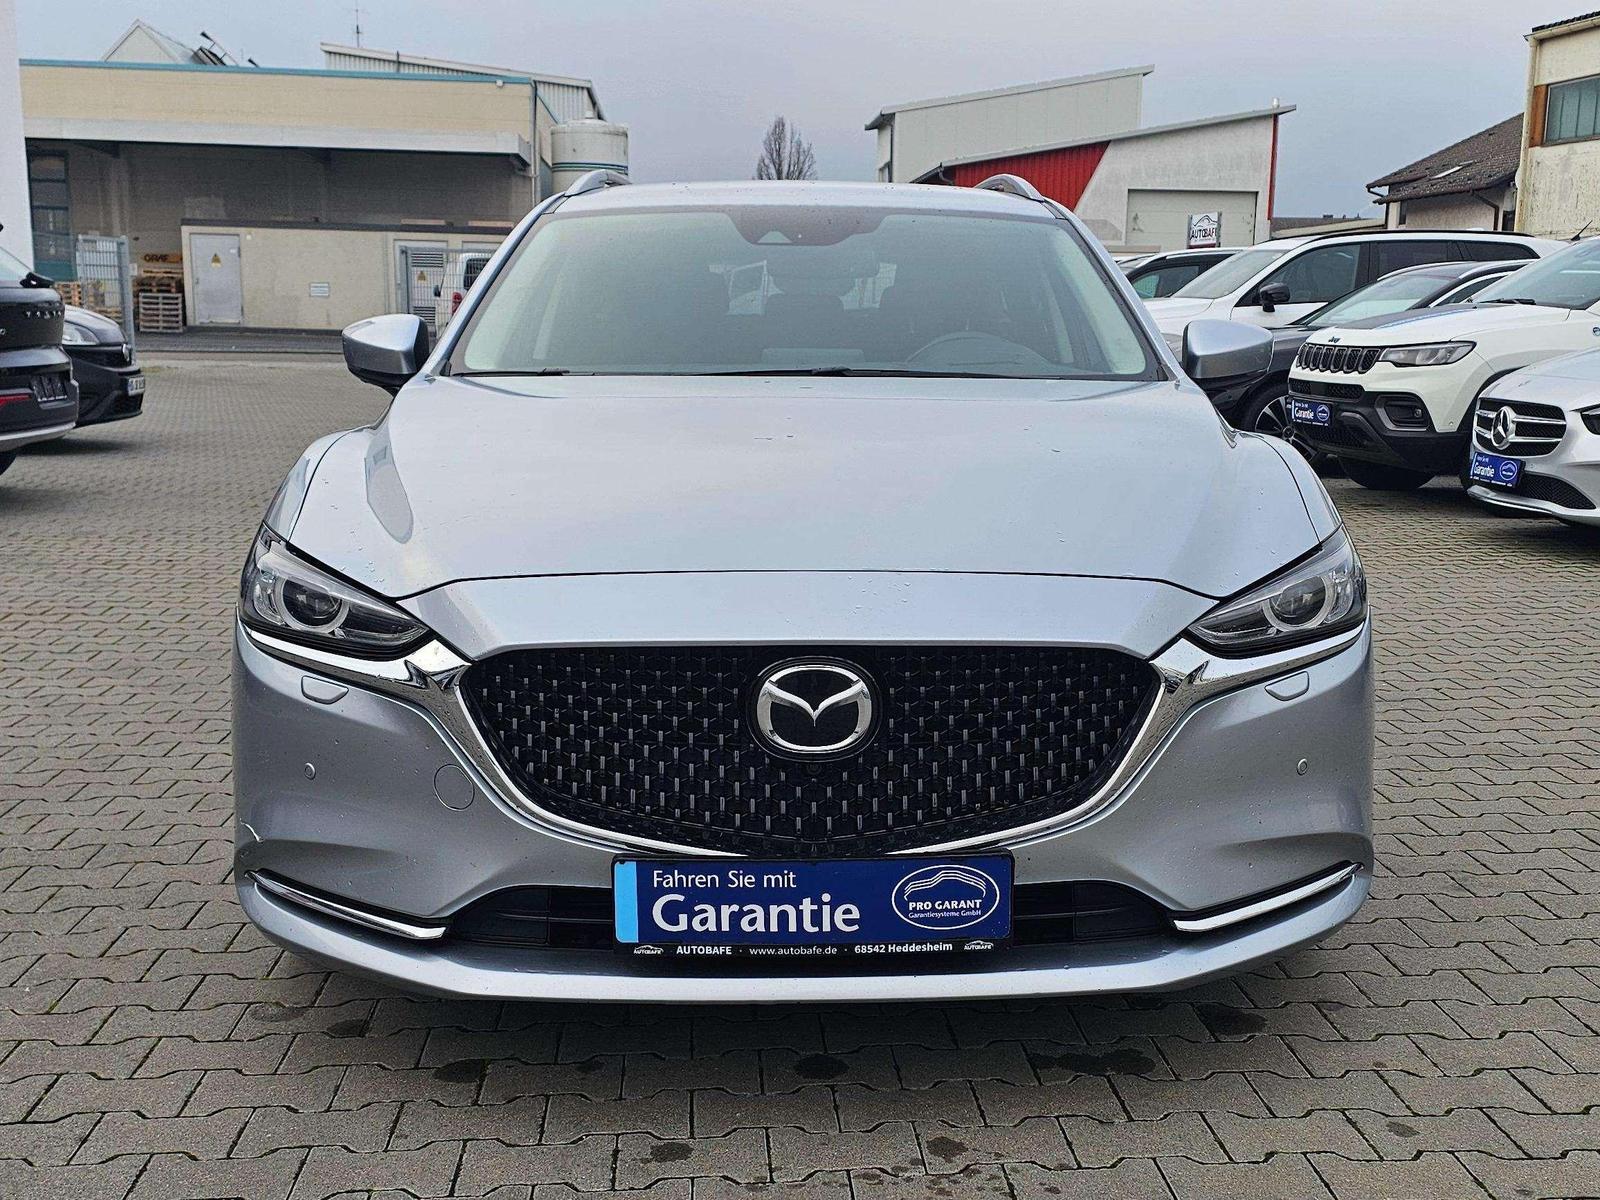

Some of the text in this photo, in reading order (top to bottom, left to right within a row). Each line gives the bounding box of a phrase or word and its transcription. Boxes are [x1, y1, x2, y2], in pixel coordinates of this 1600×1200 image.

[653, 869, 797, 888] Fahren Sie mit
[908, 899, 983, 911] PRO GARANT
[651, 892, 861, 933] Garantie
[908, 909, 982, 919] Garantiesysteme GmbH
[676, 942, 953, 956] AUTOBAFE www.autobafe.de 68542 Heddesheim
